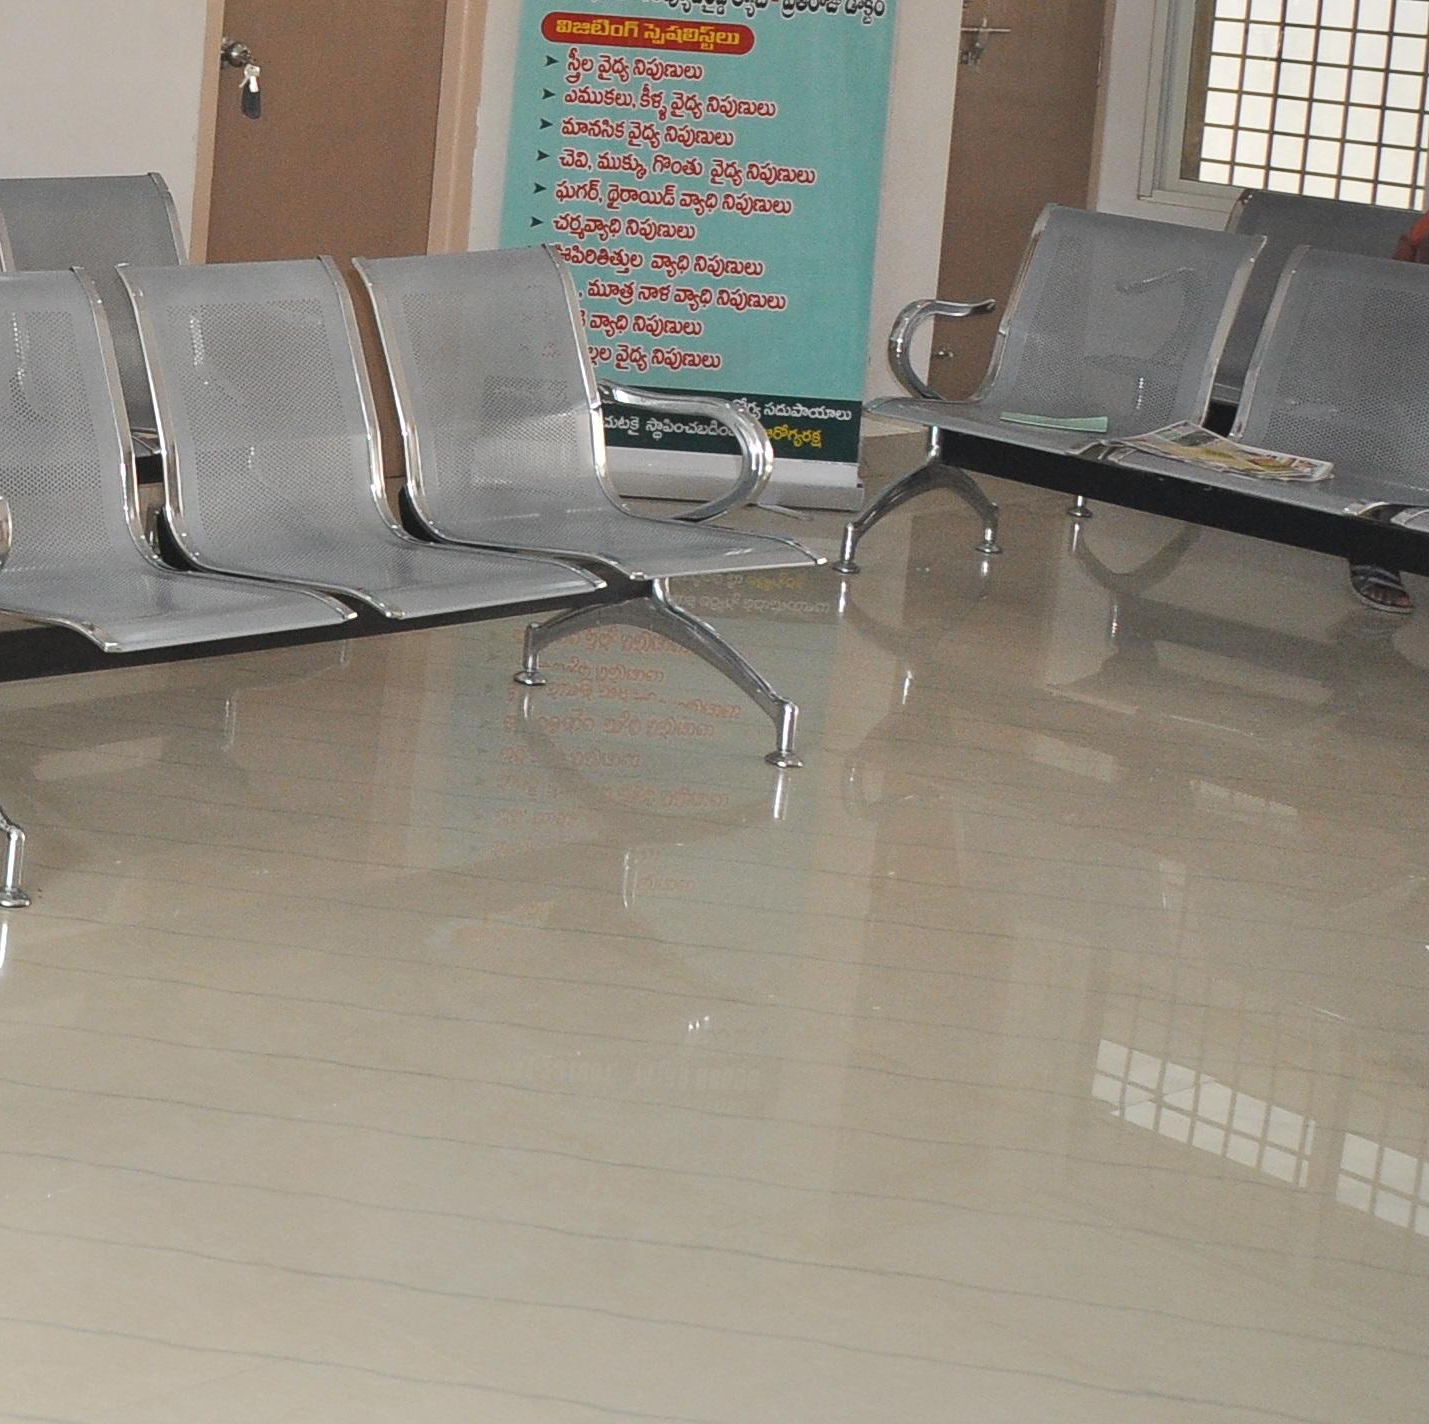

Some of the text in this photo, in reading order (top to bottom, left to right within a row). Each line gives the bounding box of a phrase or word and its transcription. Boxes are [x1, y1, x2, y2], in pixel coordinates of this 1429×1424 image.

[633, 58, 703, 80] నిపుణులు
[706, 96, 777, 118] నిపుణులు
[664, 125, 734, 146] నిపుణులు
[746, 163, 816, 184] నిపుణులు
[722, 193, 792, 214] నిపుణులు
[625, 219, 696, 240] నిపుణులు
[693, 256, 764, 276] నిపుణులు
[716, 288, 786, 311] నిపుణులు
[632, 314, 702, 336] నిపుణులు
[651, 347, 722, 370] నిపుణులు
